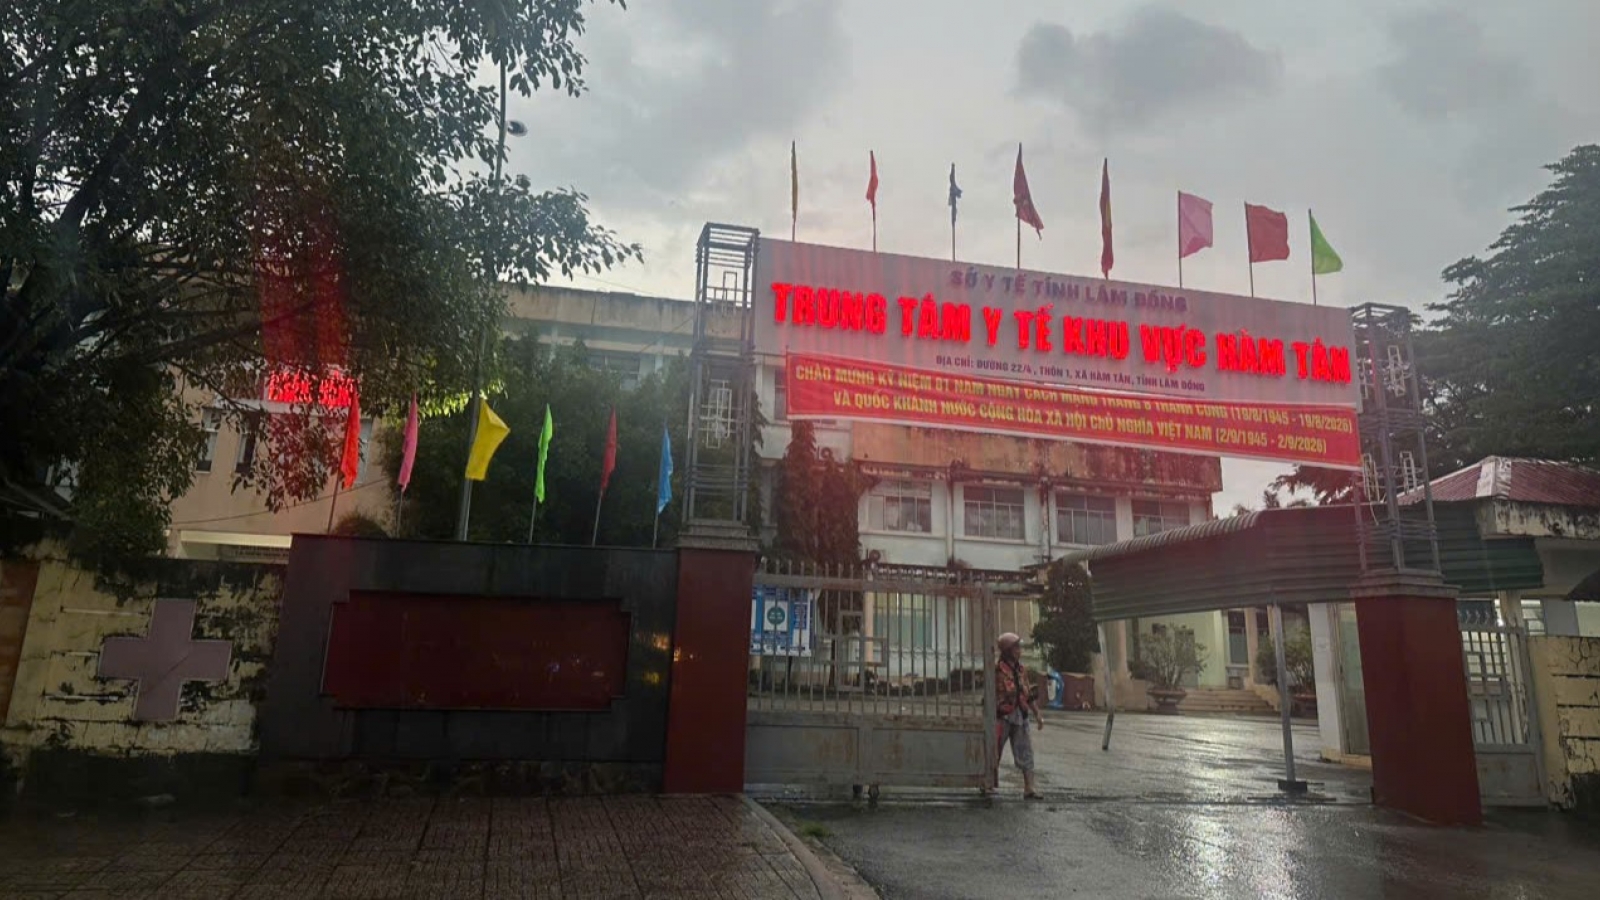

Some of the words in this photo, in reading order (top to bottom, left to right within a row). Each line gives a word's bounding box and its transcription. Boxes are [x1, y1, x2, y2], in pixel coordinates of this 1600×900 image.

[951, 267, 977, 287] SỞ
[984, 274, 994, 290] Y
[1002, 273, 1026, 292] TẾ
[1086, 283, 1127, 304] LÂM
[1135, 289, 1188, 312] ĐỒNG
[772, 282, 887, 334] TRUNG
[898, 292, 971, 342] TÂM
[983, 306, 1002, 346] Y
[1014, 303, 1054, 352] TẾ
[1063, 316, 1130, 360] KHU
[1140, 324, 1206, 373] VỰC
[1216, 329, 1286, 376] HÀM
[1292, 336, 1351, 384] TÂN
[796, 363, 830, 380] CHÀO
[936, 355, 952, 366] ĐỊA
[977, 359, 1008, 371] ĐƯỜNG
[1040, 366, 1063, 378] THÔN
[1075, 369, 1087, 380] XÃ
[1090, 371, 1110, 382] HÀM
[1160, 377, 1178, 389] LÂM
[1182, 379, 1205, 392] ĐỒNG
[834, 388, 850, 405] VÀ
[855, 390, 890, 409] QUỐC
[894, 395, 937, 414] KHÁNH
[942, 399, 976, 416] NƯỚC
[980, 402, 1014, 421] CỘNG
[1047, 409, 1062, 425] XÃ
[1066, 412, 1086, 430] HỘI
[1117, 417, 1154, 434] NGHĨA
[1157, 420, 1181, 440] VIỆT
[1185, 424, 1212, 441] NAM
